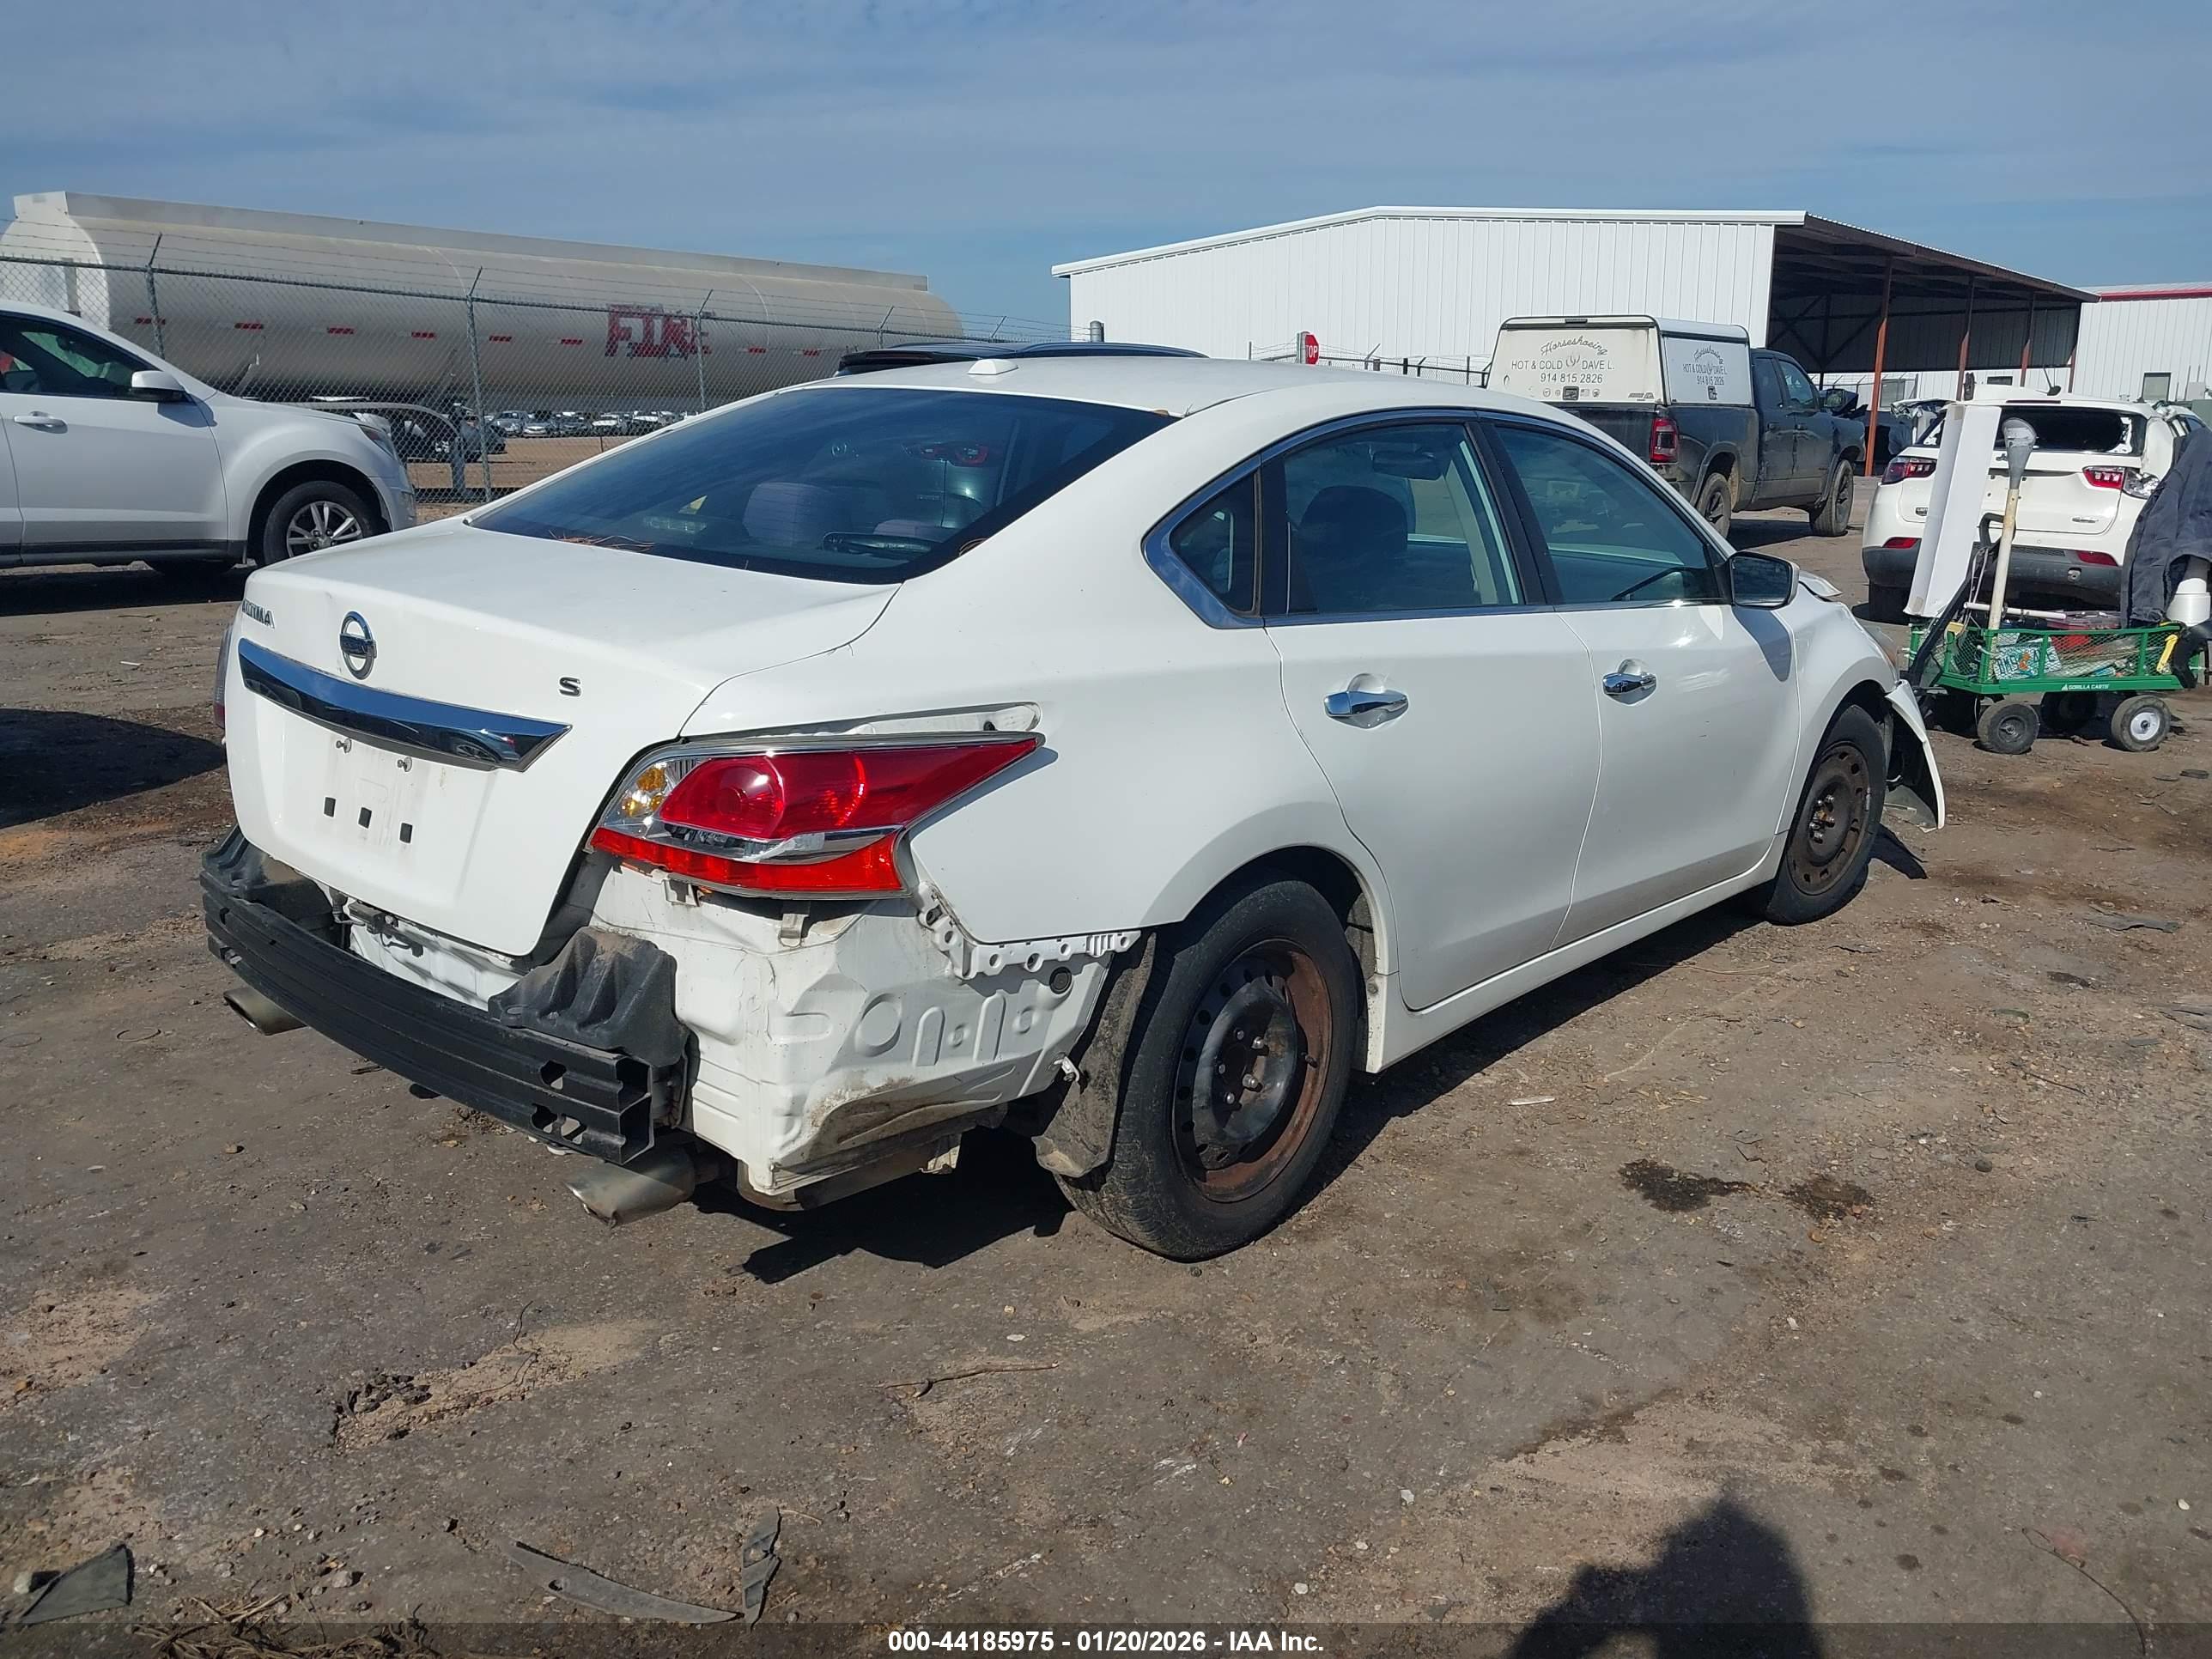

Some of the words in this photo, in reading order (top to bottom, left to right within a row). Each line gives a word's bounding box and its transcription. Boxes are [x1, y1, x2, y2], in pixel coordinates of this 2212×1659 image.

[1305, 344, 1318, 358] TOP
[1540, 335, 1608, 356] Horseshoeing
[1511, 360, 1529, 370] HOT
[1531, 360, 1536, 370] &
[1539, 360, 1563, 370] COLD
[1582, 360, 1605, 370] DAVE
[1540, 373, 1557, 383] 914
[1560, 373, 1577, 383] 815
[1580, 374, 1603, 384] 2826
[559, 677, 581, 696] S
